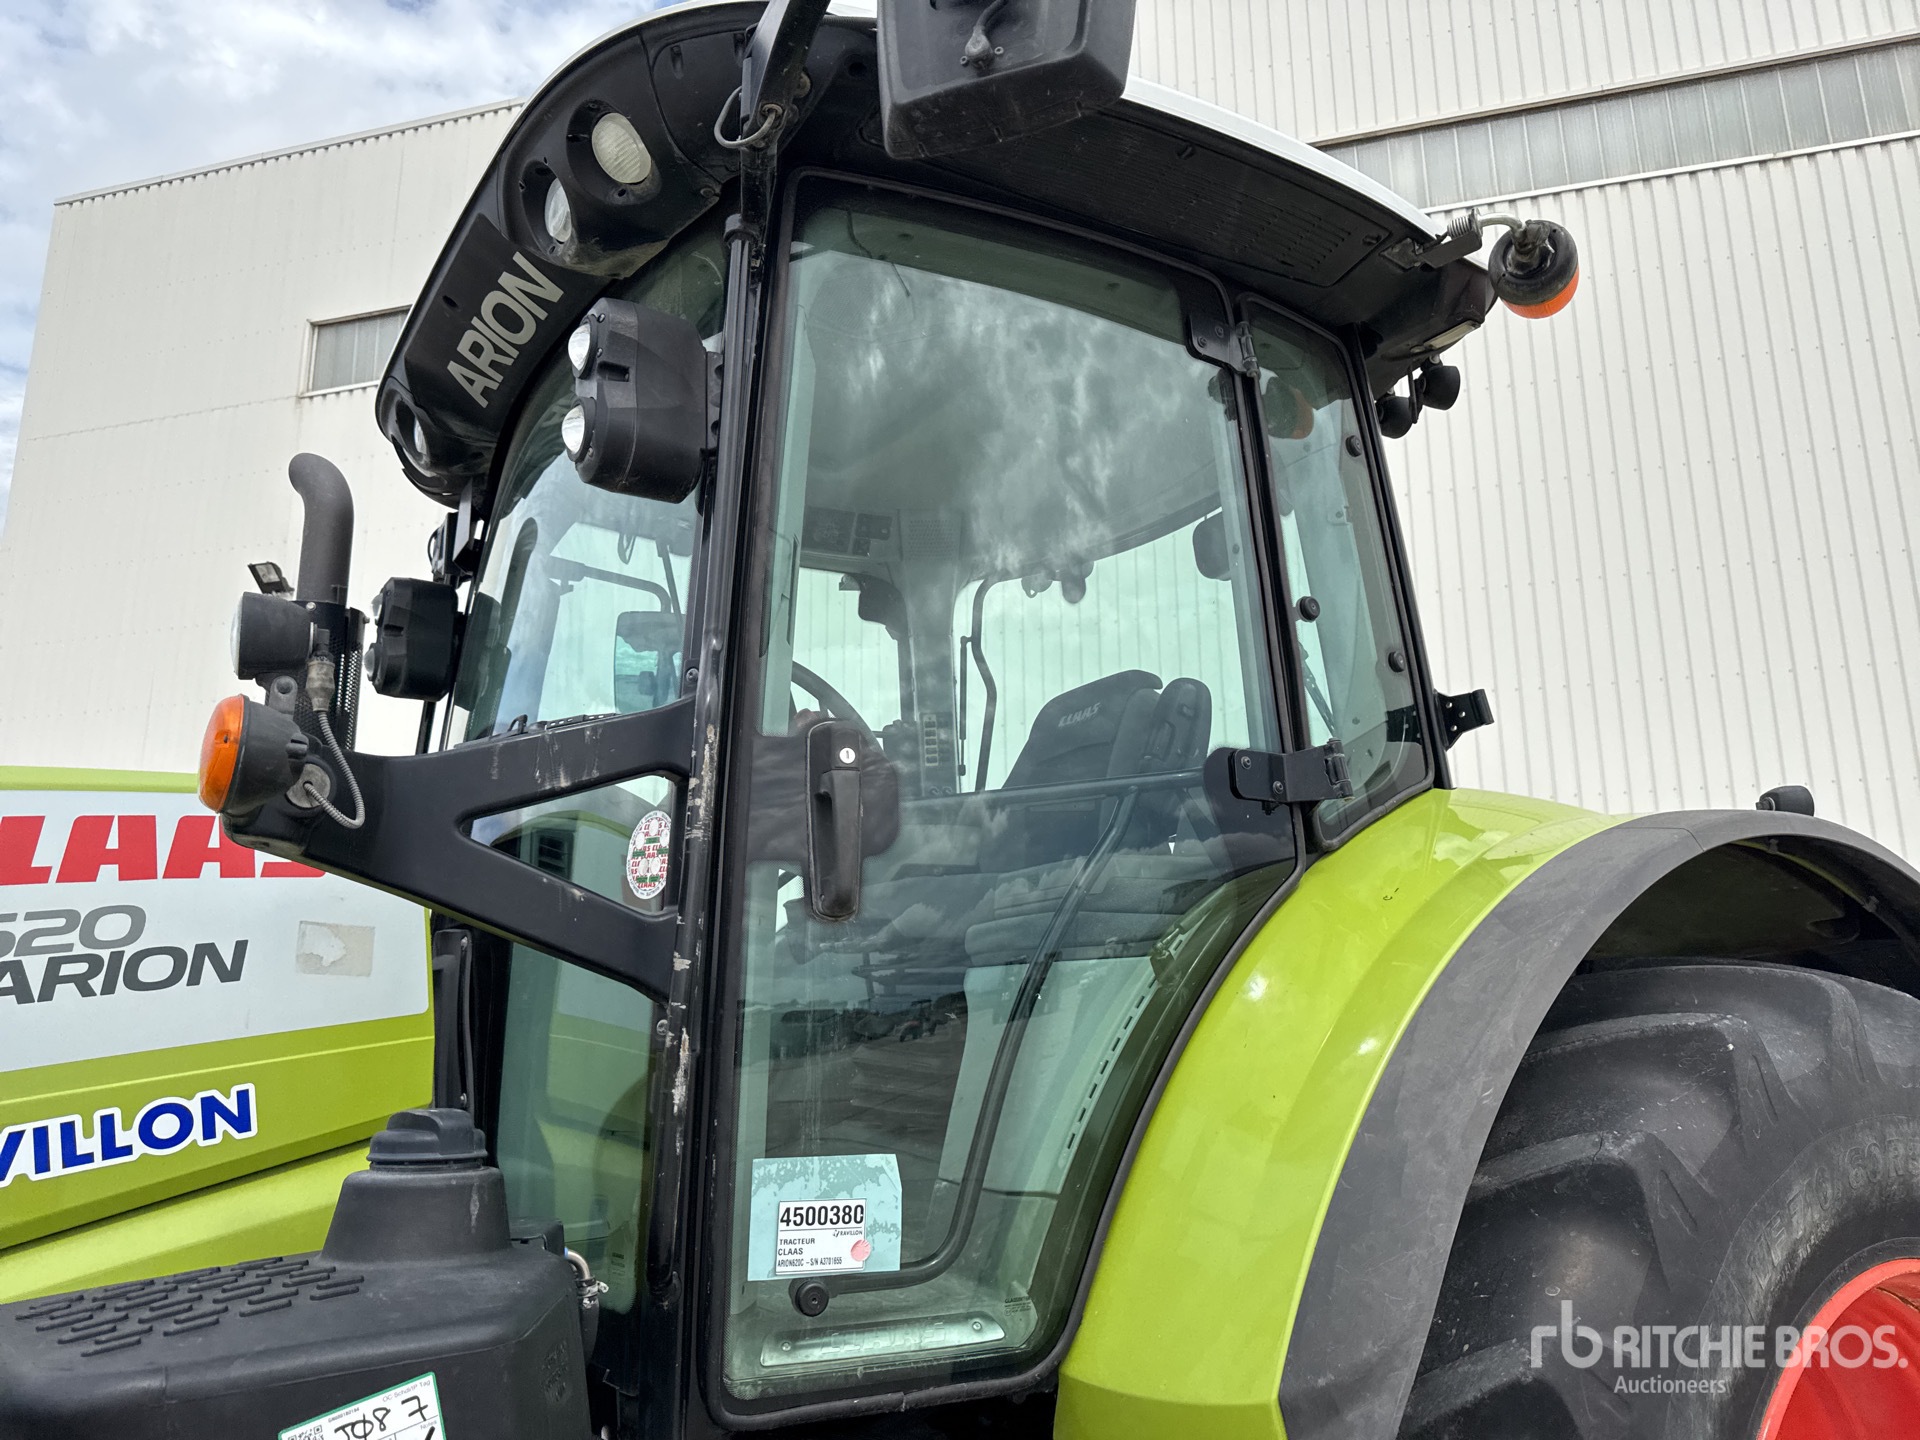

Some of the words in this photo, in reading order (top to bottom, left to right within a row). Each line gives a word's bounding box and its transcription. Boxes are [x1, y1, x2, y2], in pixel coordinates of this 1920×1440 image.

[446, 251, 564, 408] ARION
[1057, 702, 1101, 728] CLAAS
[0, 815, 326, 887] LAA
[0, 940, 249, 1005] ARION
[779, 1204, 865, 1227] 4500380
[777, 1247, 804, 1256] CLAAS
[779, 1238, 816, 1246] TRACTEUR
[419, 1380, 431, 1389] Tag
